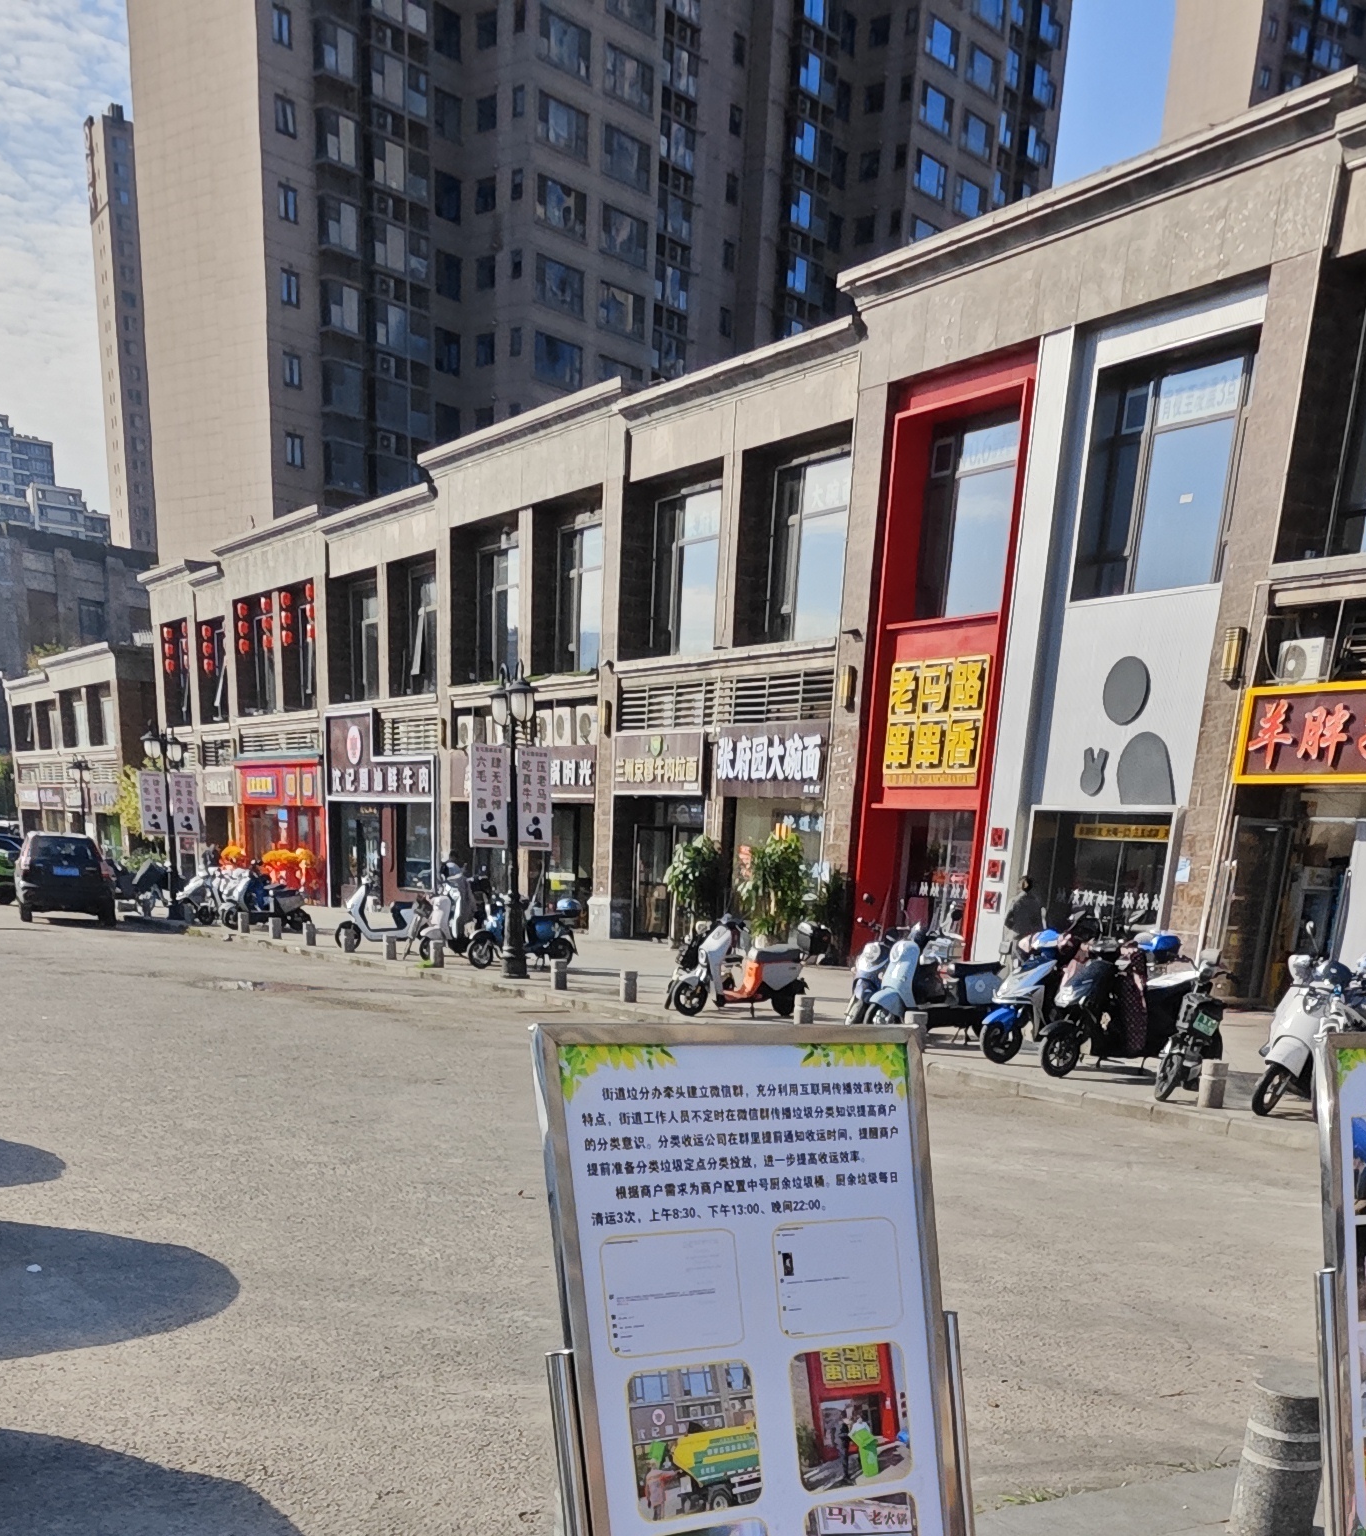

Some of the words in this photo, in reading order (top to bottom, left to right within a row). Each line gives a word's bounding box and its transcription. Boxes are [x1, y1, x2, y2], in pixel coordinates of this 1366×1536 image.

[890, 661, 982, 713] 老马路
[717, 732, 822, 781] 张府园大碗面
[885, 720, 975, 768] 串串香
